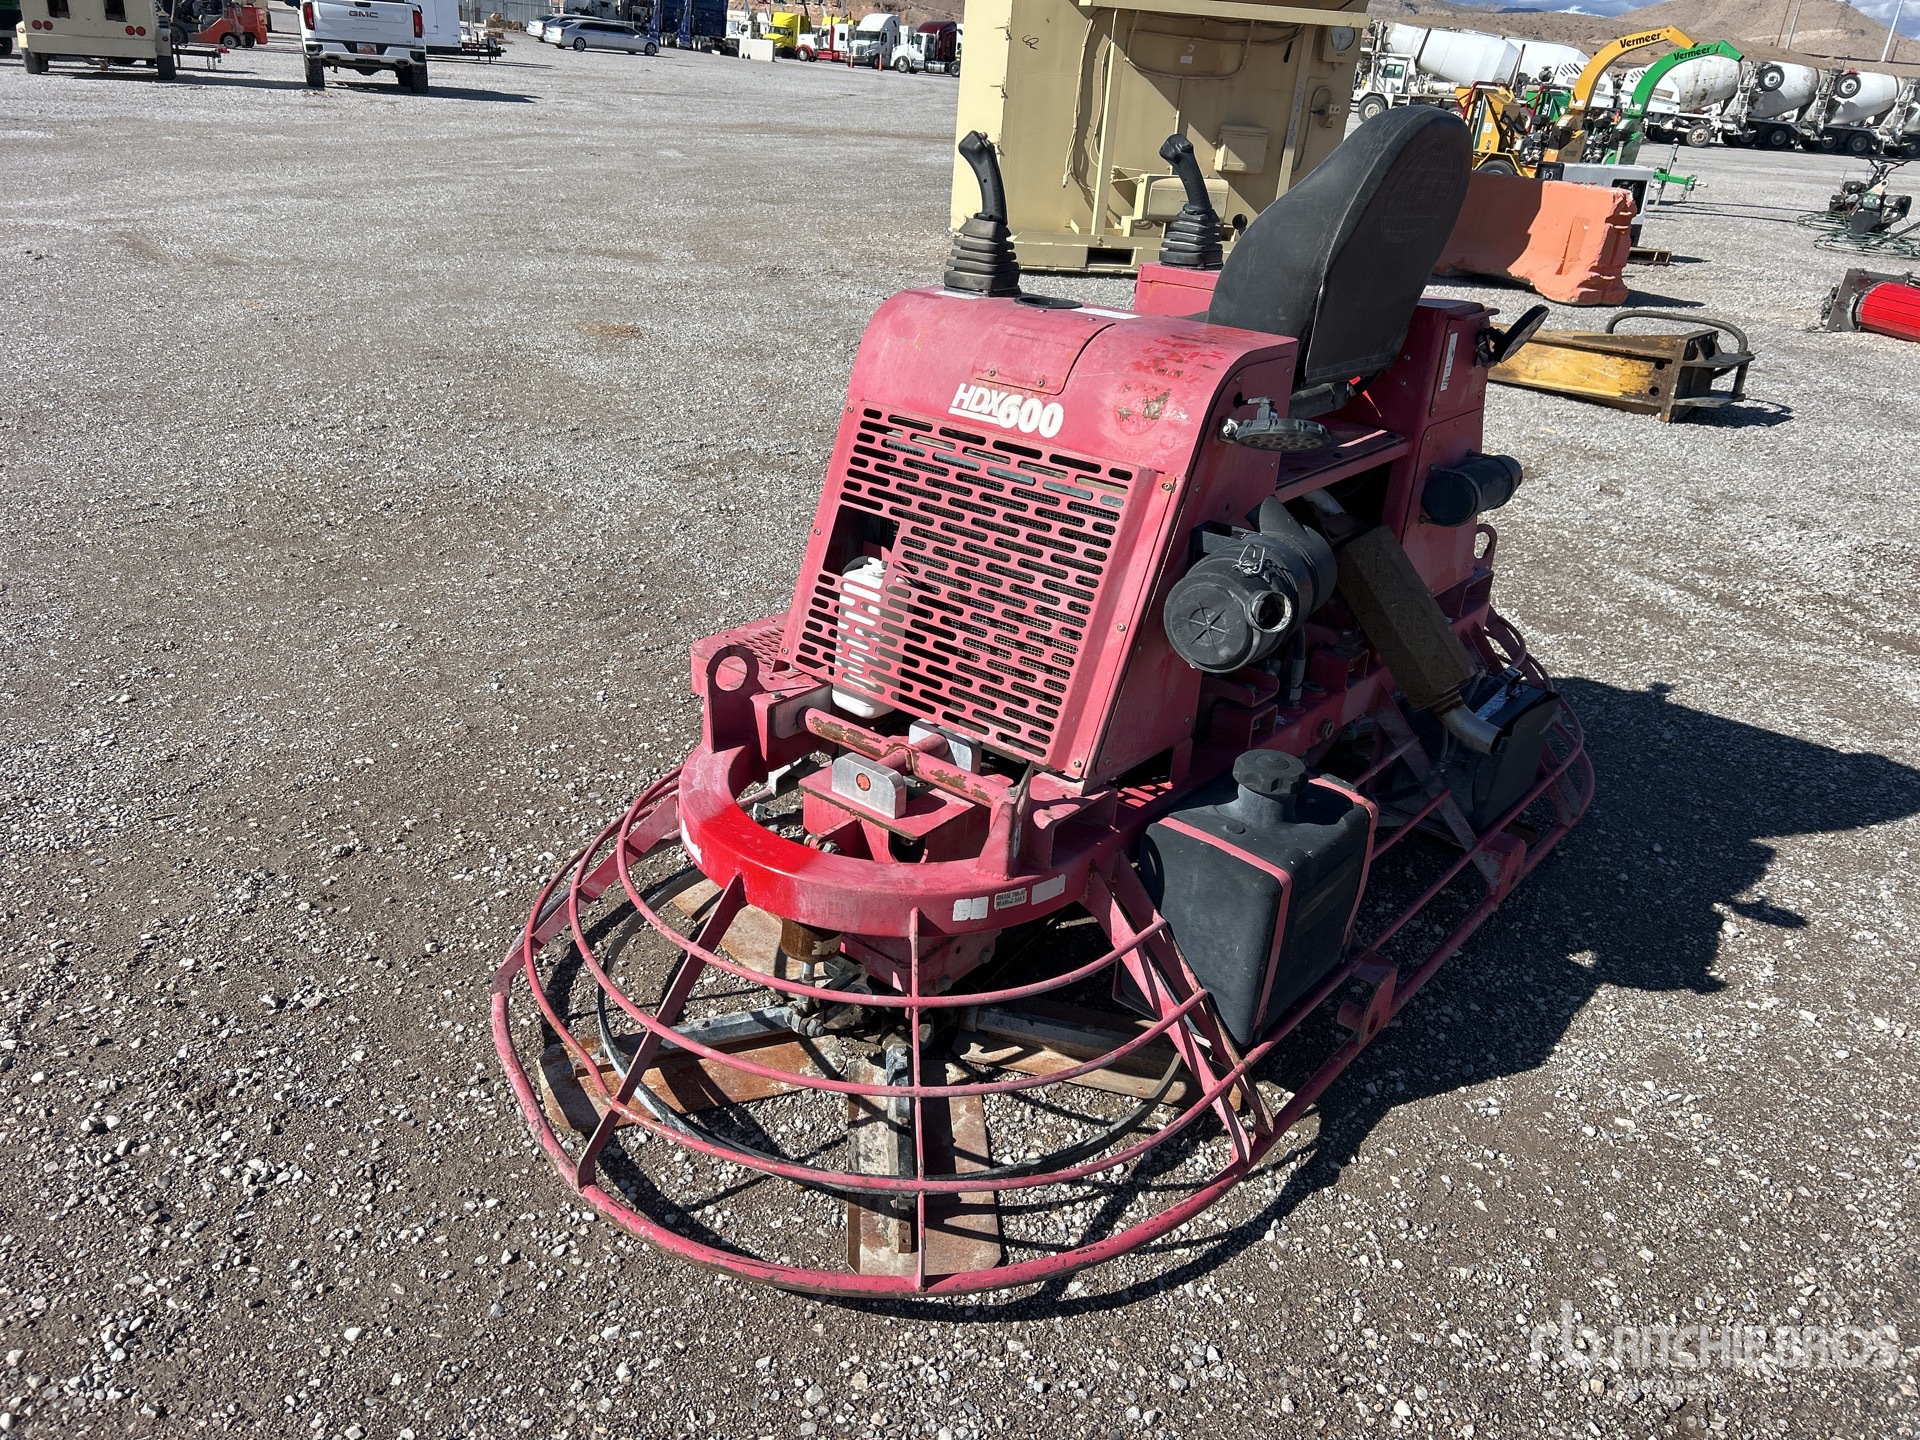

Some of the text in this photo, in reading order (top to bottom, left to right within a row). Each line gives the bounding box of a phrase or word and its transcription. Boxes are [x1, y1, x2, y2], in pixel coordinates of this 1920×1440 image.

[348, 10, 379, 18] GMC
[1619, 32, 1661, 49] Vermeer
[1673, 46, 1711, 60] Vermeer
[948, 383, 1064, 438] HDX600
